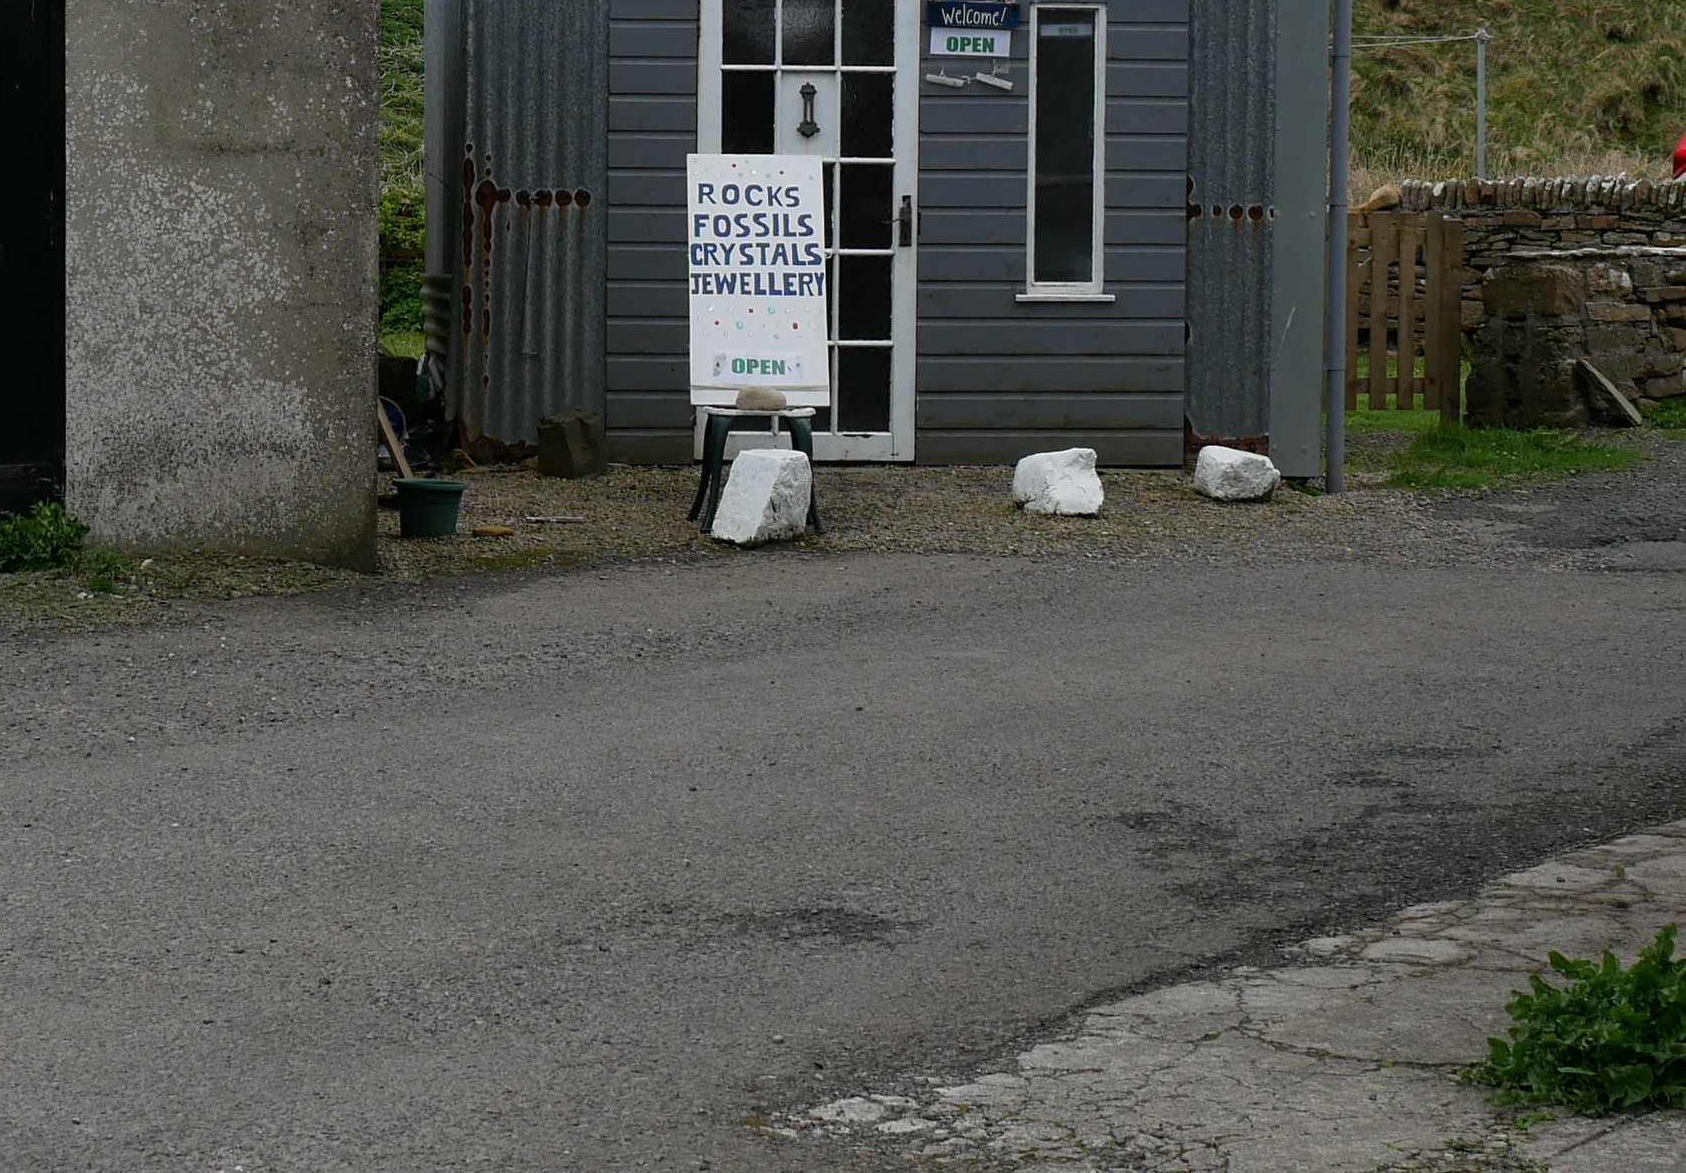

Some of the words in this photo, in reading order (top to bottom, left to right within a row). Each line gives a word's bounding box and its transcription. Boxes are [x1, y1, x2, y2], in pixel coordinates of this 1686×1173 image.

[941, 4, 1006, 25] Welcome!
[946, 36, 995, 53] OPEN
[698, 183, 800, 207] ROCKS
[694, 213, 814, 237] FOSSILS
[690, 243, 822, 266] CRYSTALS
[690, 272, 825, 296] JEWELLERY
[731, 358, 786, 375] OPEN
